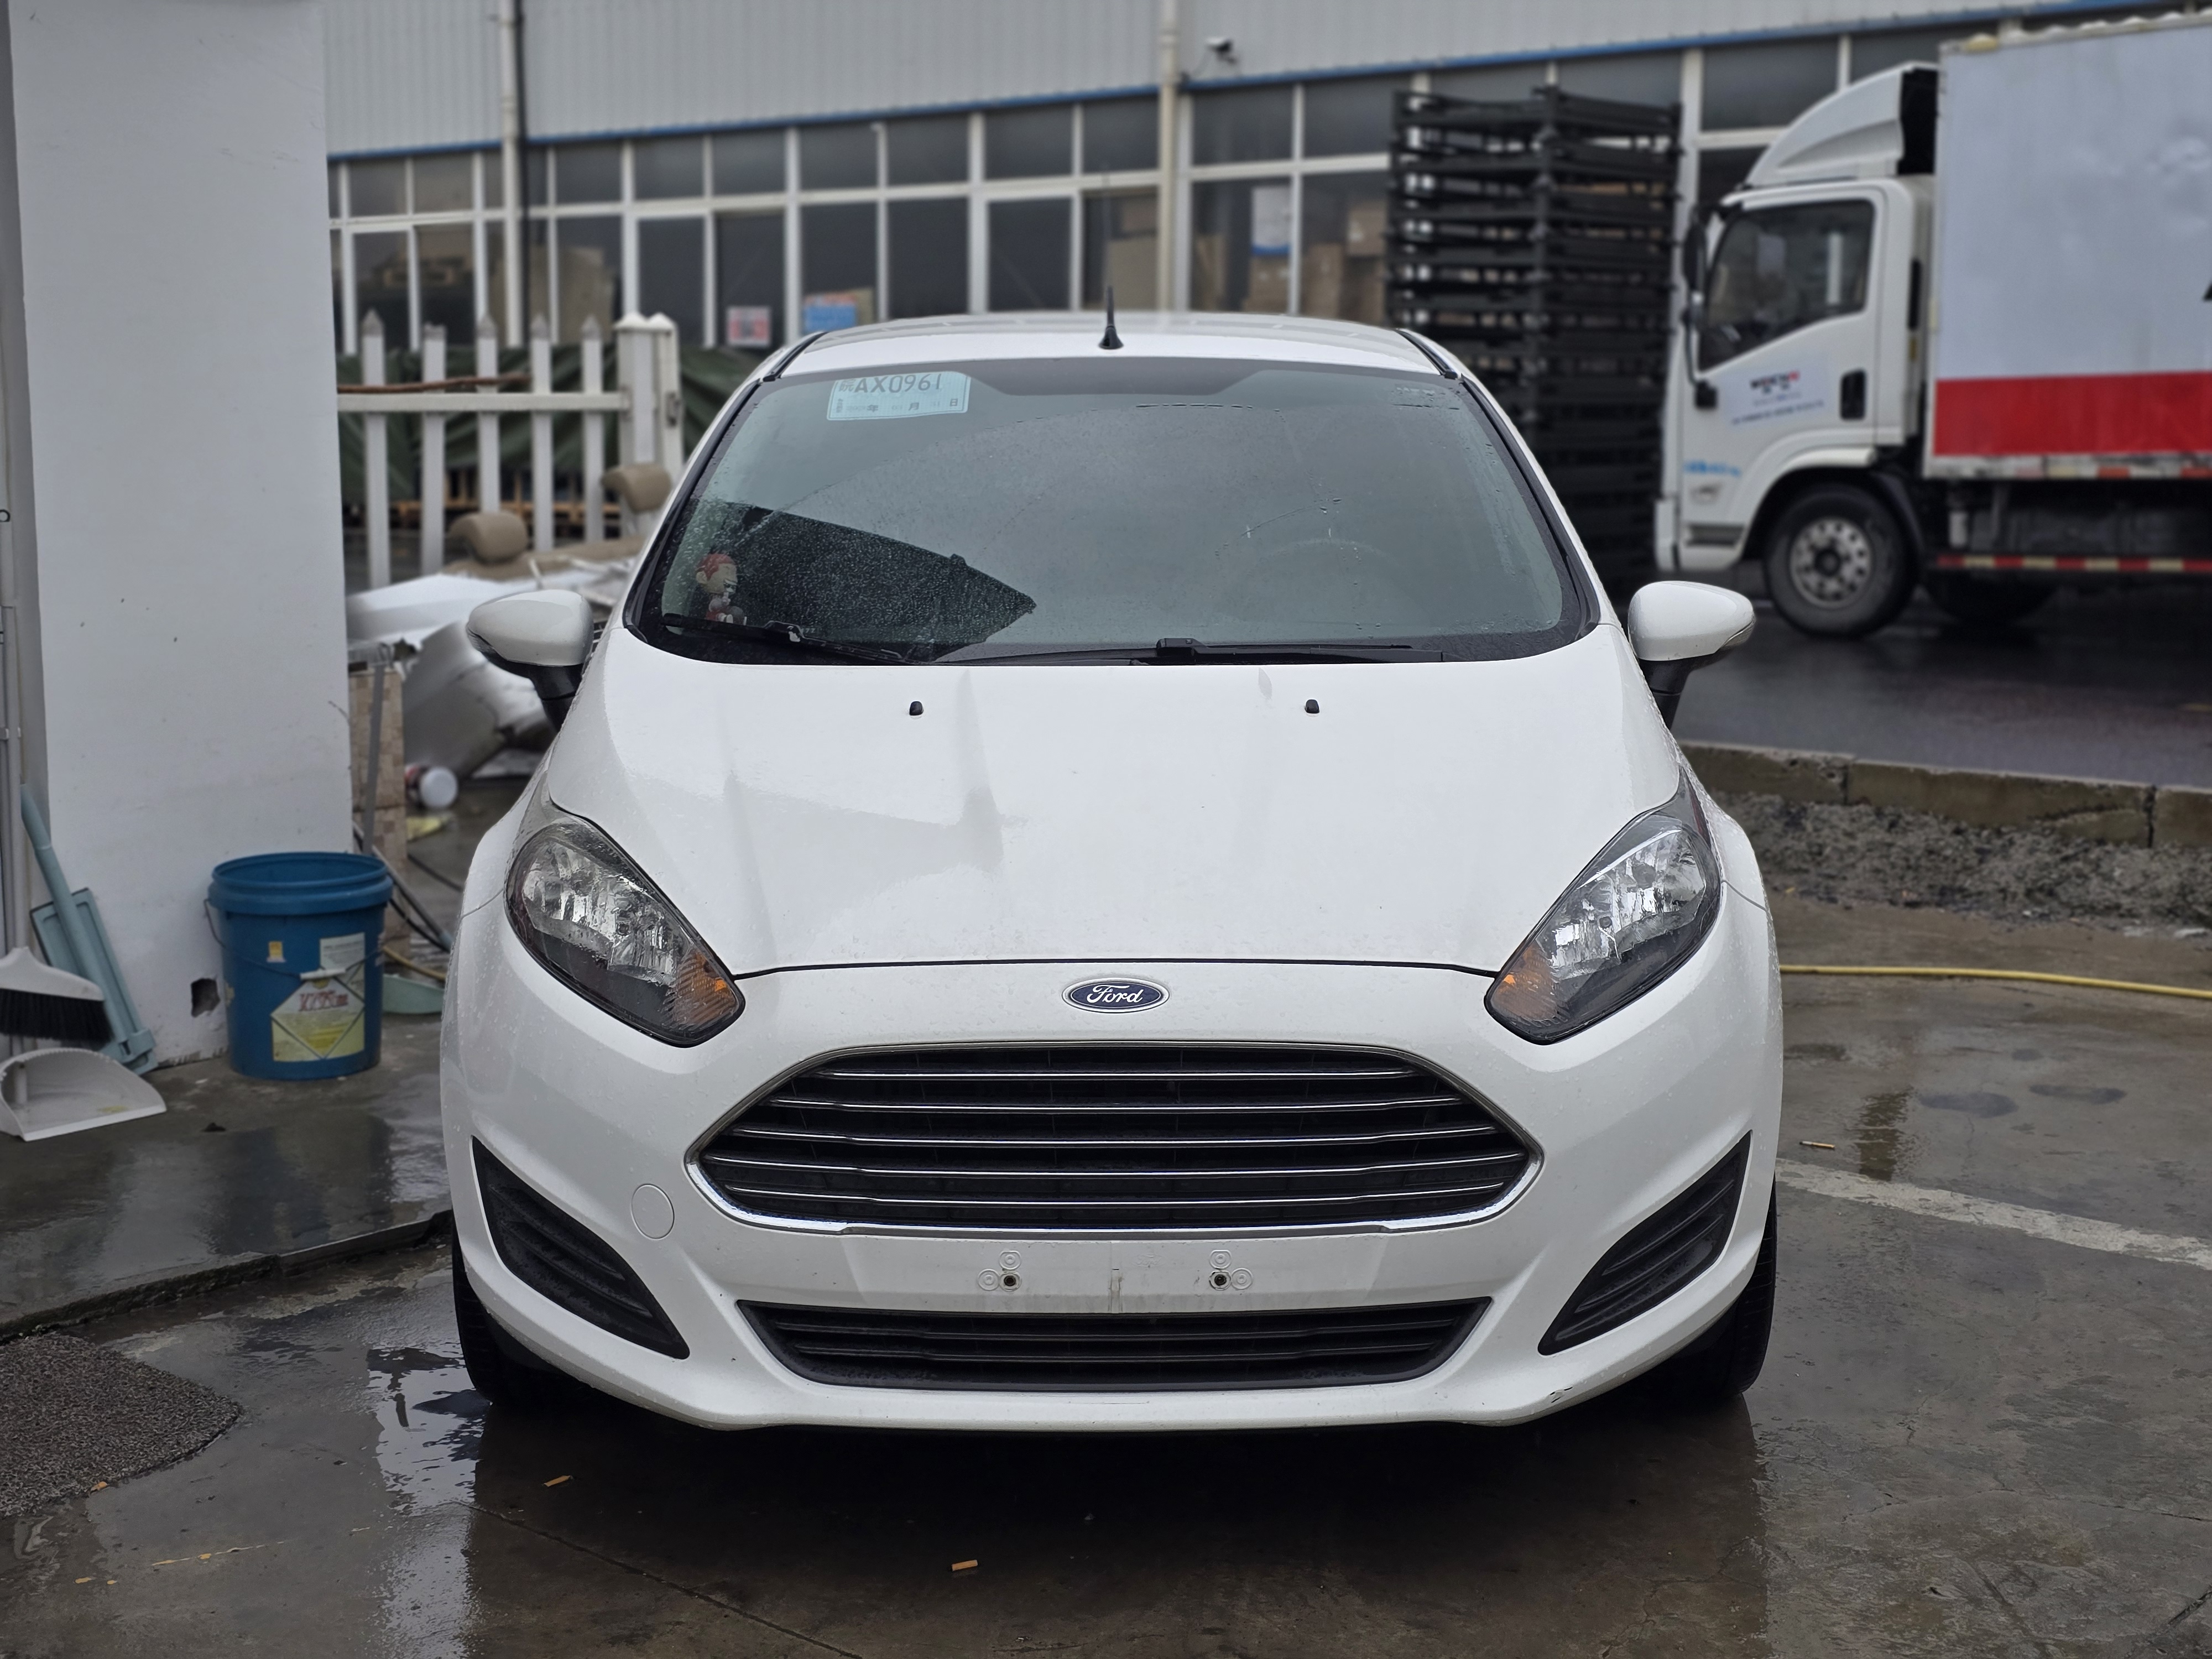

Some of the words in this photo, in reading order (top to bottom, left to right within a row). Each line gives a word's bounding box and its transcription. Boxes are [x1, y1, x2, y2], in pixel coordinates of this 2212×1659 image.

[867, 404, 879, 413] 年
[908, 402, 920, 411] 月
[950, 398, 958, 406] 日
[1087, 984, 1143, 1003] Ford
